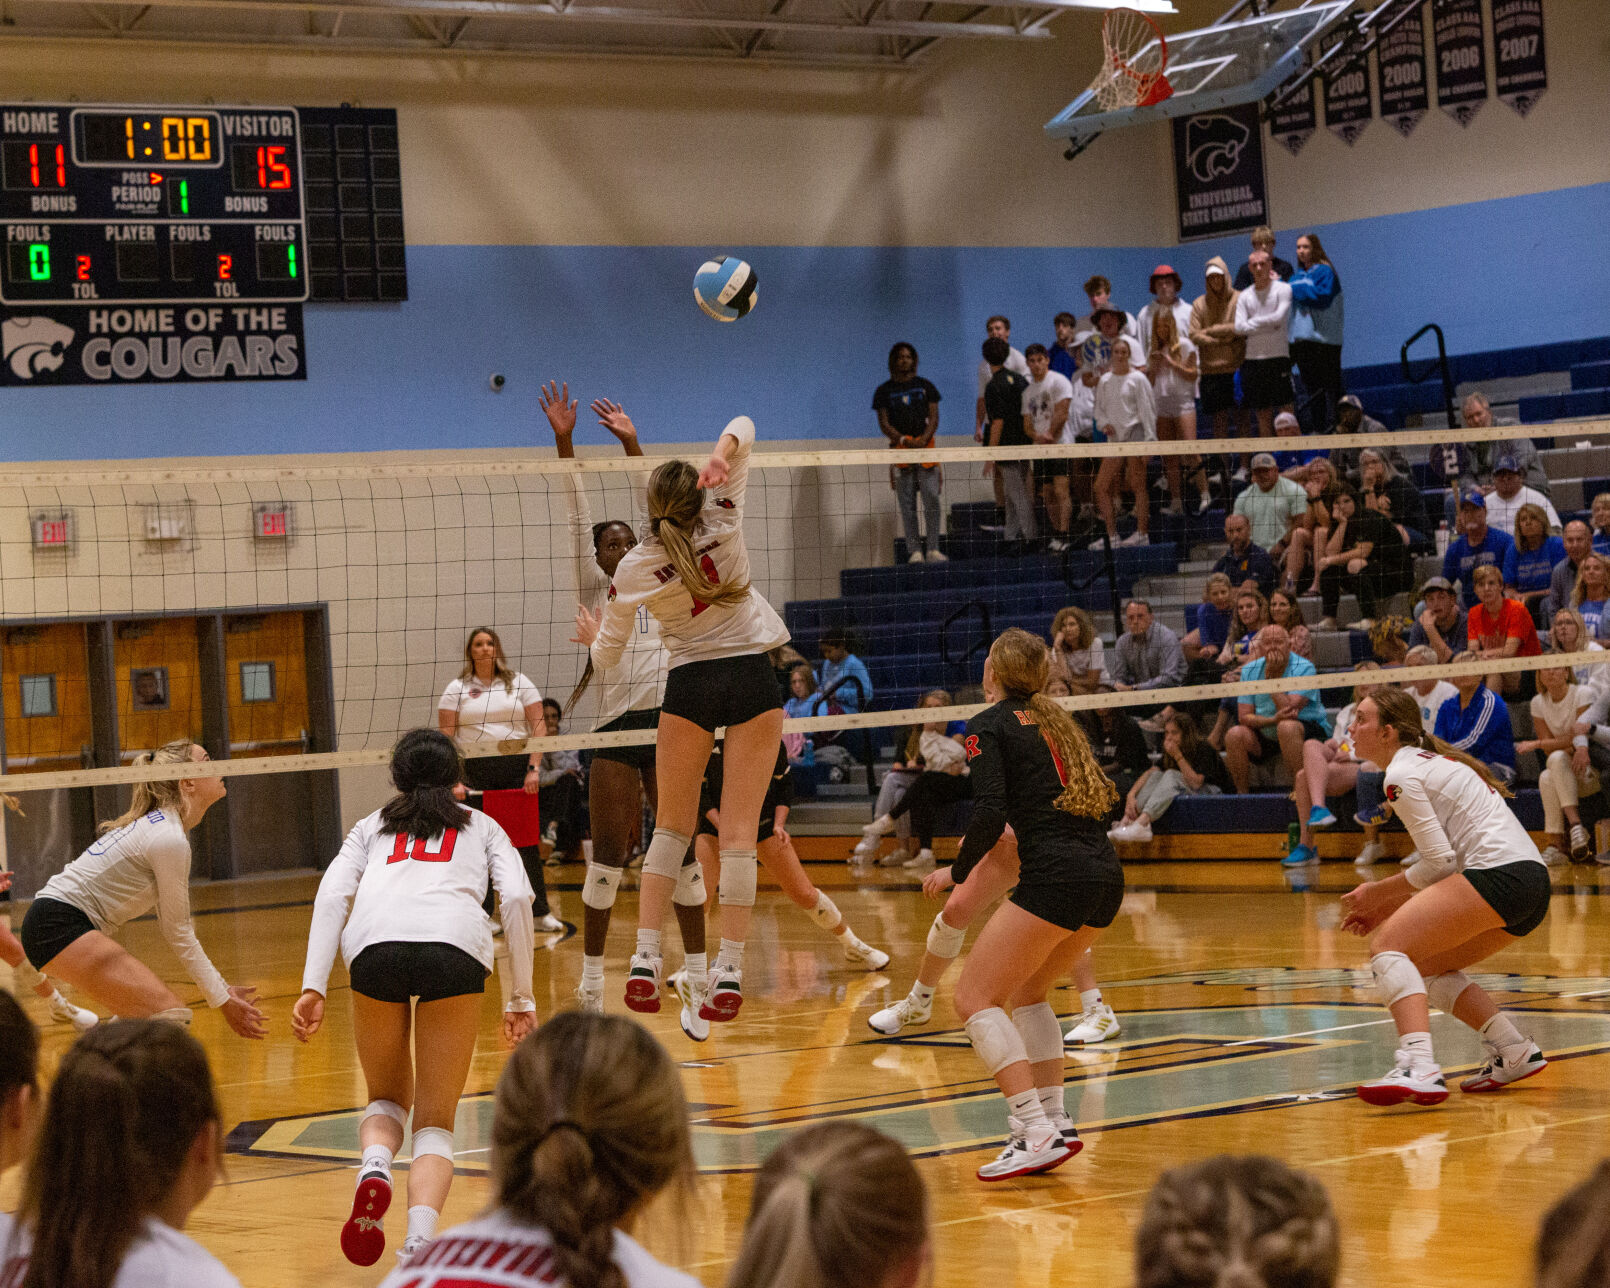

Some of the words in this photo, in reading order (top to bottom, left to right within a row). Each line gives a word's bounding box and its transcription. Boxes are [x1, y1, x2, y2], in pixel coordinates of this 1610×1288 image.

[1500, 34, 1539, 62] 2007
[1384, 61, 1422, 88] 2000
[3, 112, 59, 134] HOME
[223, 115, 294, 136] VISITOR
[125, 117, 211, 160] 1:00
[29, 143, 66, 188] 11
[257, 146, 291, 189] 15
[31, 195, 77, 212] BONUS
[111, 186, 162, 203] PERIOD
[179, 179, 189, 215] 1
[224, 196, 268, 213] BONUS
[1189, 185, 1254, 209] INDIVIDUAL
[1182, 208, 1211, 227] STATE
[1210, 199, 1264, 223] CHAMPIONS
[7, 225, 51, 241] FOULS
[105, 225, 156, 241] PLAYER
[169, 225, 211, 241] FOULS
[255, 225, 296, 241] FOULS
[29, 243, 51, 281] 0
[76, 255, 92, 281] 2
[218, 254, 232, 280] 2
[287, 243, 297, 278] 1
[71, 282, 100, 299] TOL
[213, 281, 240, 298] TOL
[89, 308, 175, 334] HOME
[184, 308, 223, 332] OF
[232, 307, 288, 332] THE
[81, 334, 299, 380] COUGARS
[43, 520, 67, 544] EXIT
[263, 512, 286, 536] EXIT
[964, 734, 982, 762] R
[386, 826, 459, 866] 10
